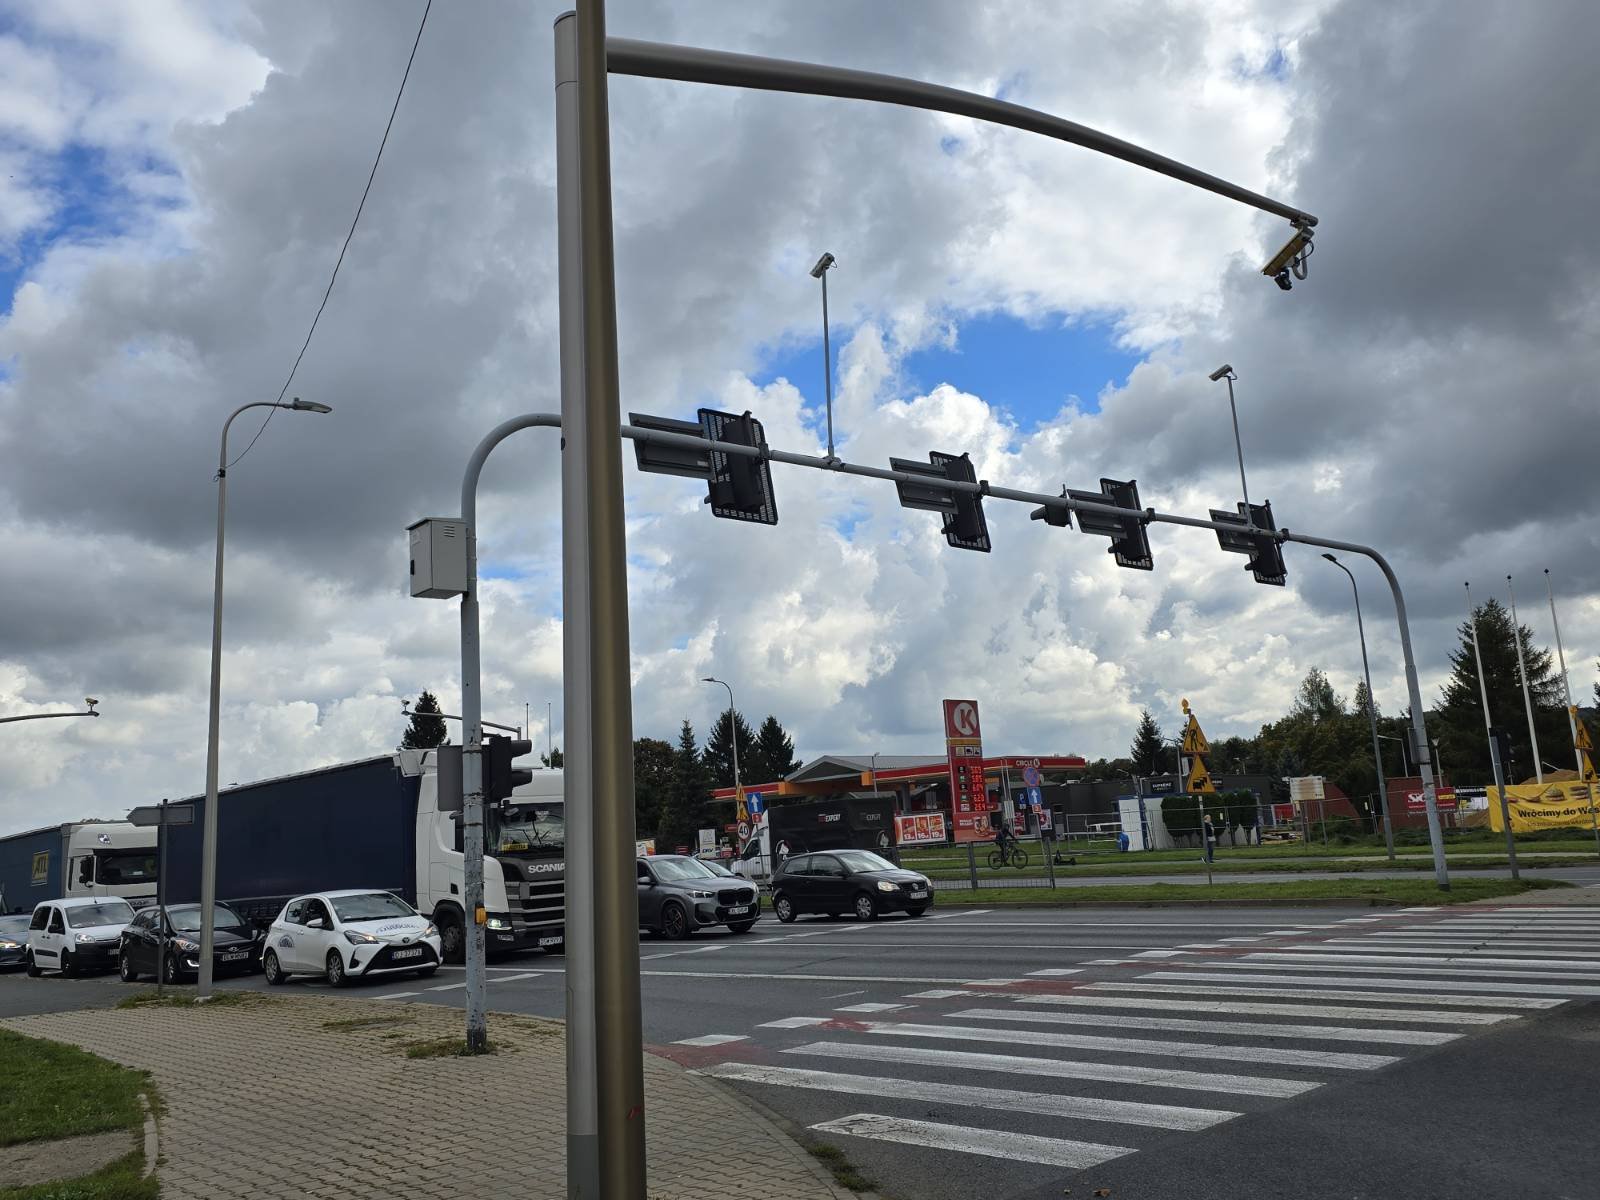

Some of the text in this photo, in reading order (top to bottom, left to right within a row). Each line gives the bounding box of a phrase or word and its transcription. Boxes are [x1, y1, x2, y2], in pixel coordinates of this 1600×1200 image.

[957, 706, 977, 733] K
[1016, 759, 1033, 767] CIRCLE
[1518, 809, 1560, 818] Wrócimy
[1563, 807, 1576, 816] do
[739, 825, 749, 835] 40
[527, 862, 566, 874] SCANIA
